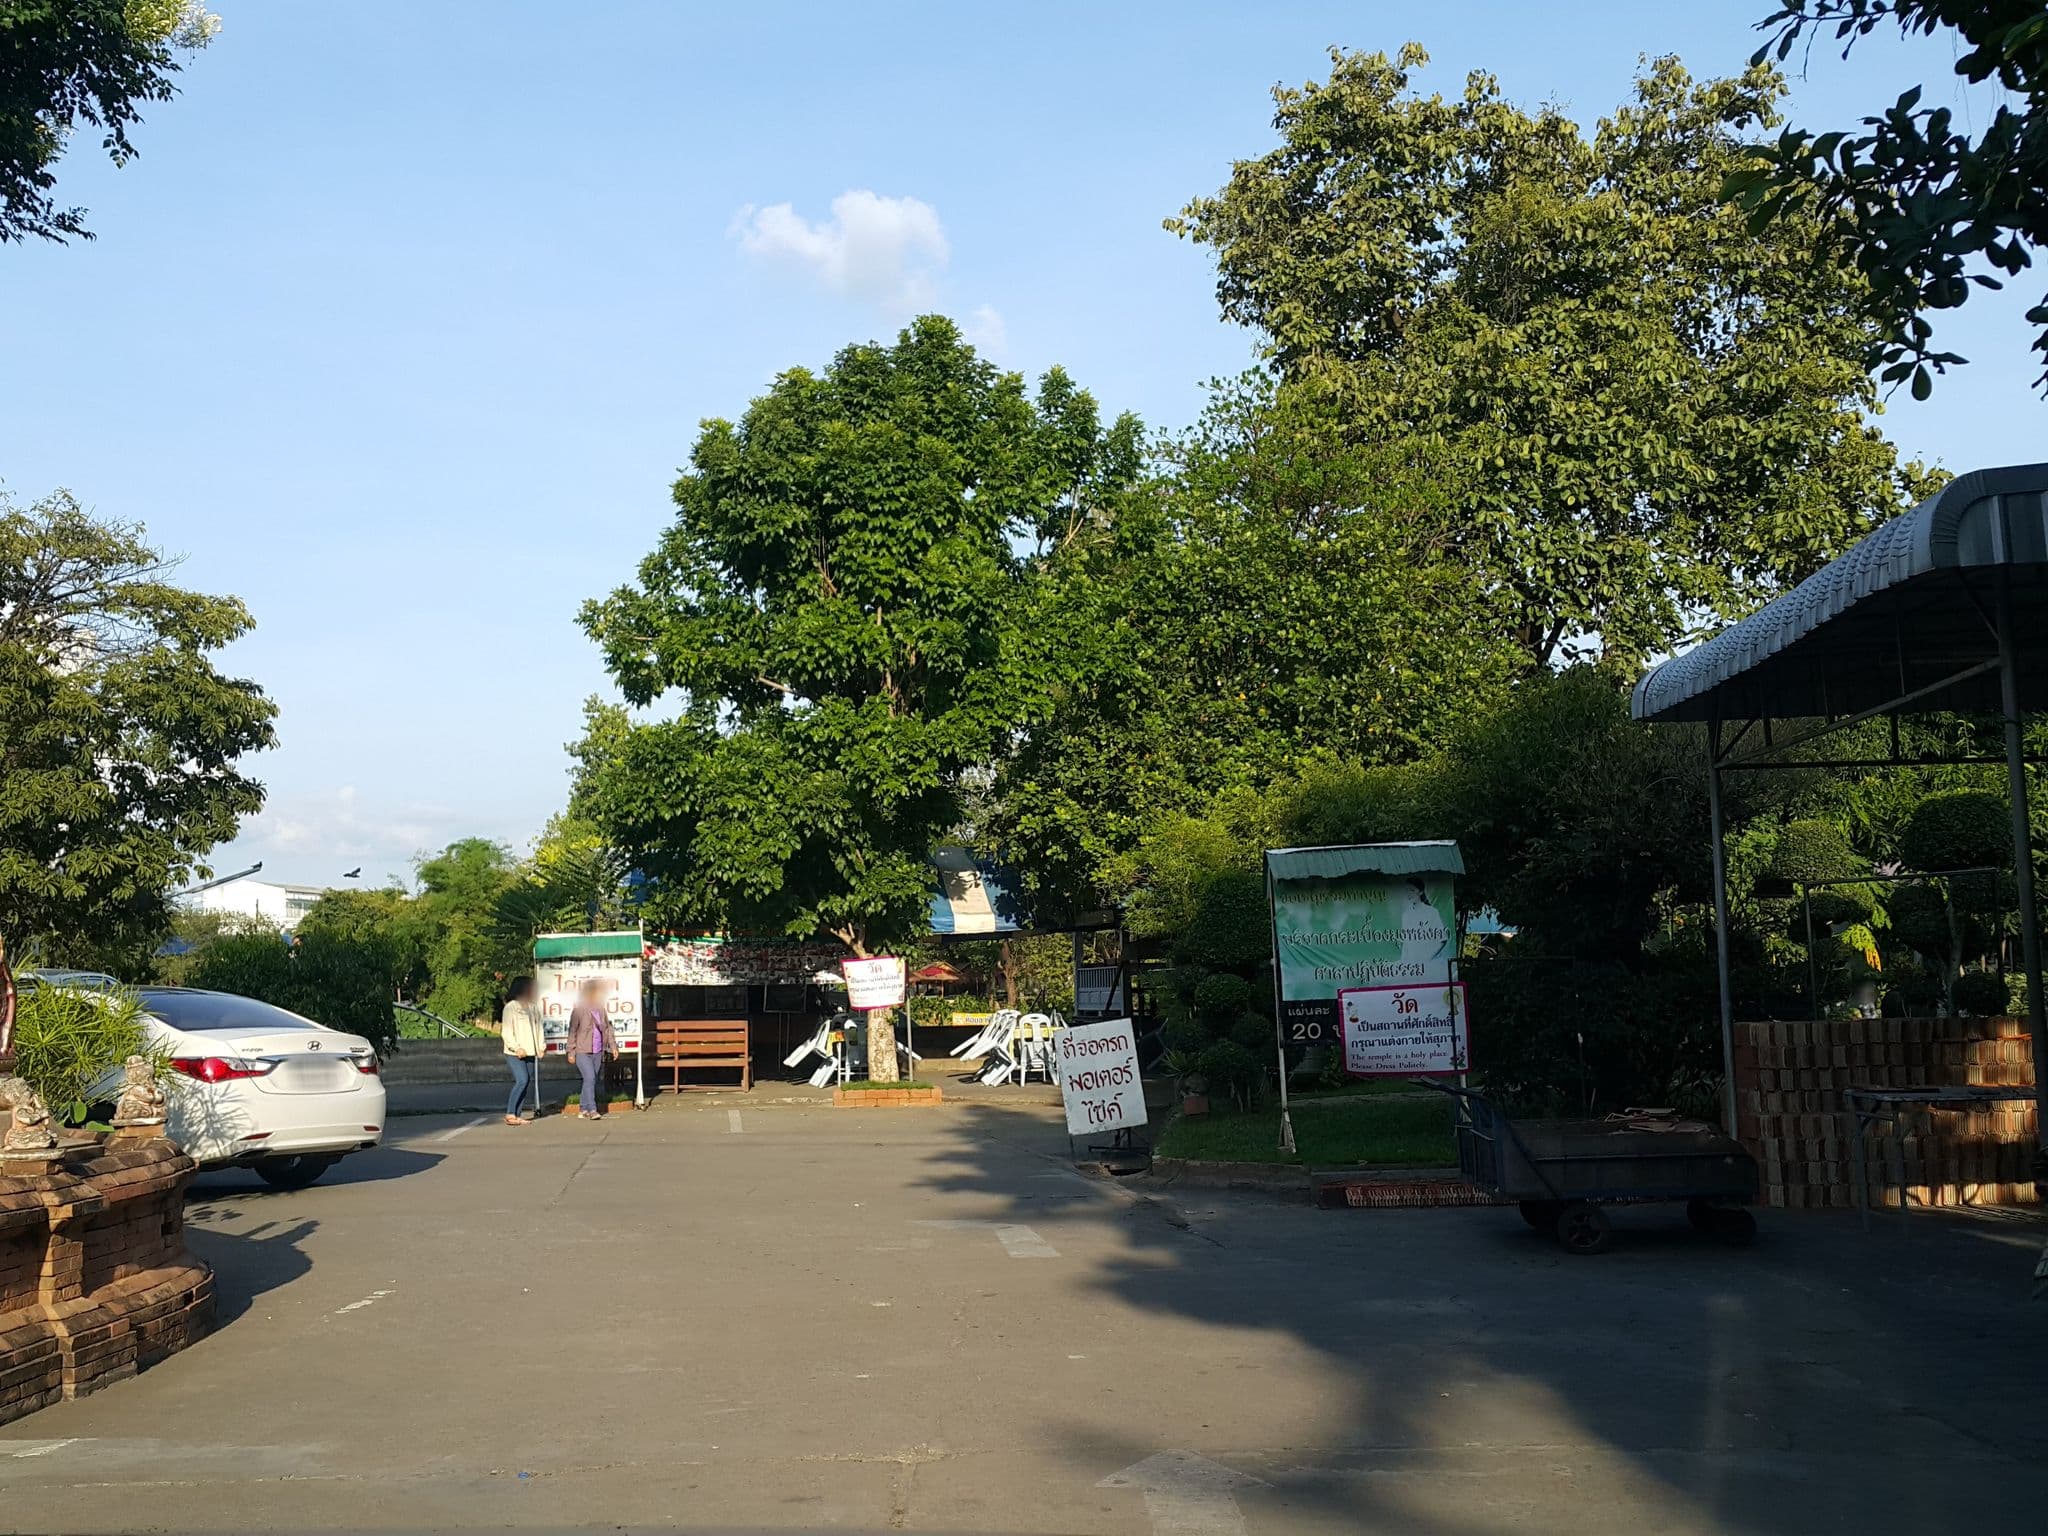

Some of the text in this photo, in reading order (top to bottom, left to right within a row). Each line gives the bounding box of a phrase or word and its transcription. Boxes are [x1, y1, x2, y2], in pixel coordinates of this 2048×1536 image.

[1314, 959, 1425, 983] ศาลาปฏิบัติธรรม
[1288, 1003, 1330, 1017] แผ่นละ
[1391, 992, 1419, 1014] วัด
[1292, 1022, 1322, 1040] 20
[1358, 1013, 1454, 1033] เป็นสถานที่ศักดิ์สิทธิ์
[1062, 1031, 1129, 1059] ที่จอดรถ
[1411, 1051, 1426, 1060] holy
